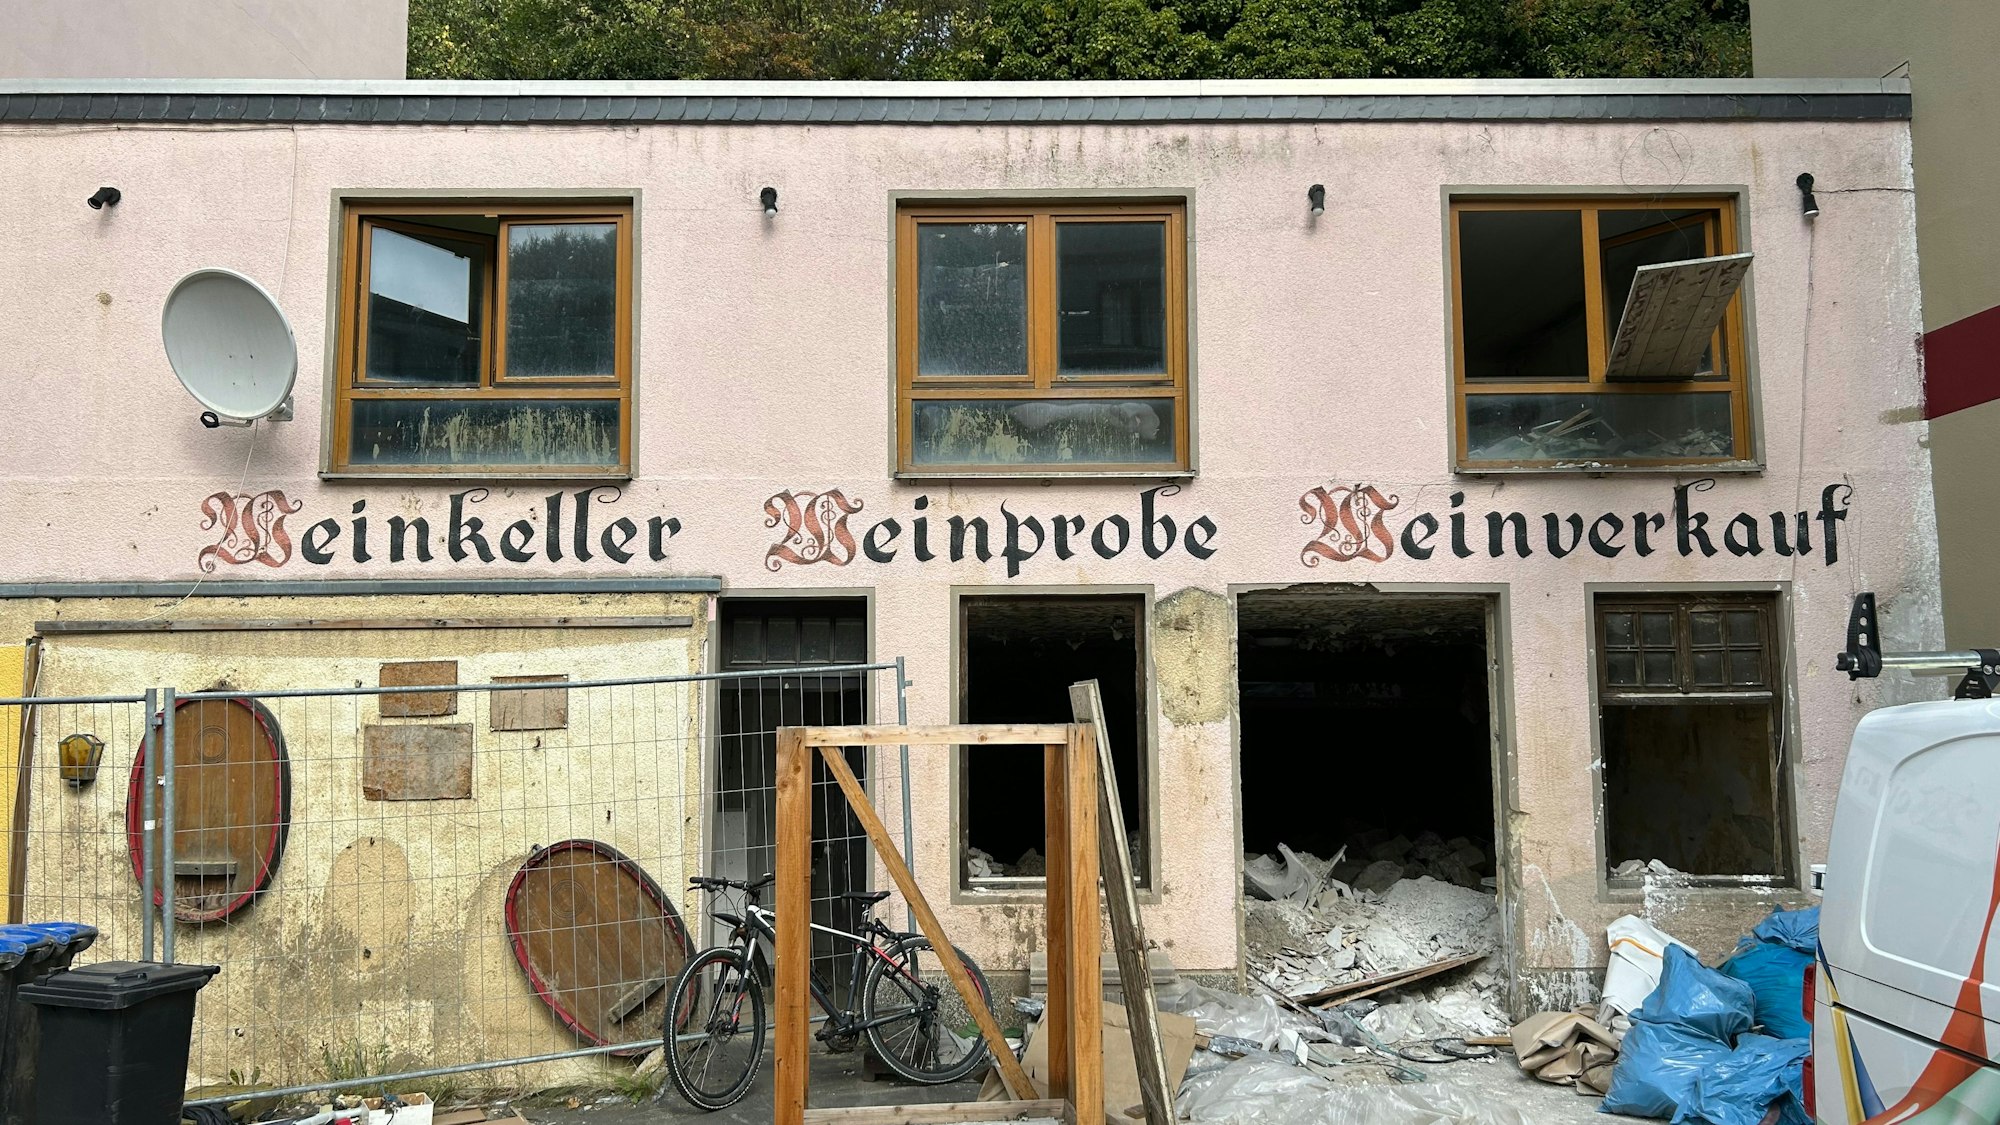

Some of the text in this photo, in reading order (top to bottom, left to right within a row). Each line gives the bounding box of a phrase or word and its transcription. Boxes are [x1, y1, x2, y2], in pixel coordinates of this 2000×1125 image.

[199, 478, 1851, 578] Weinkeller Weinprobe Weinverkauf
